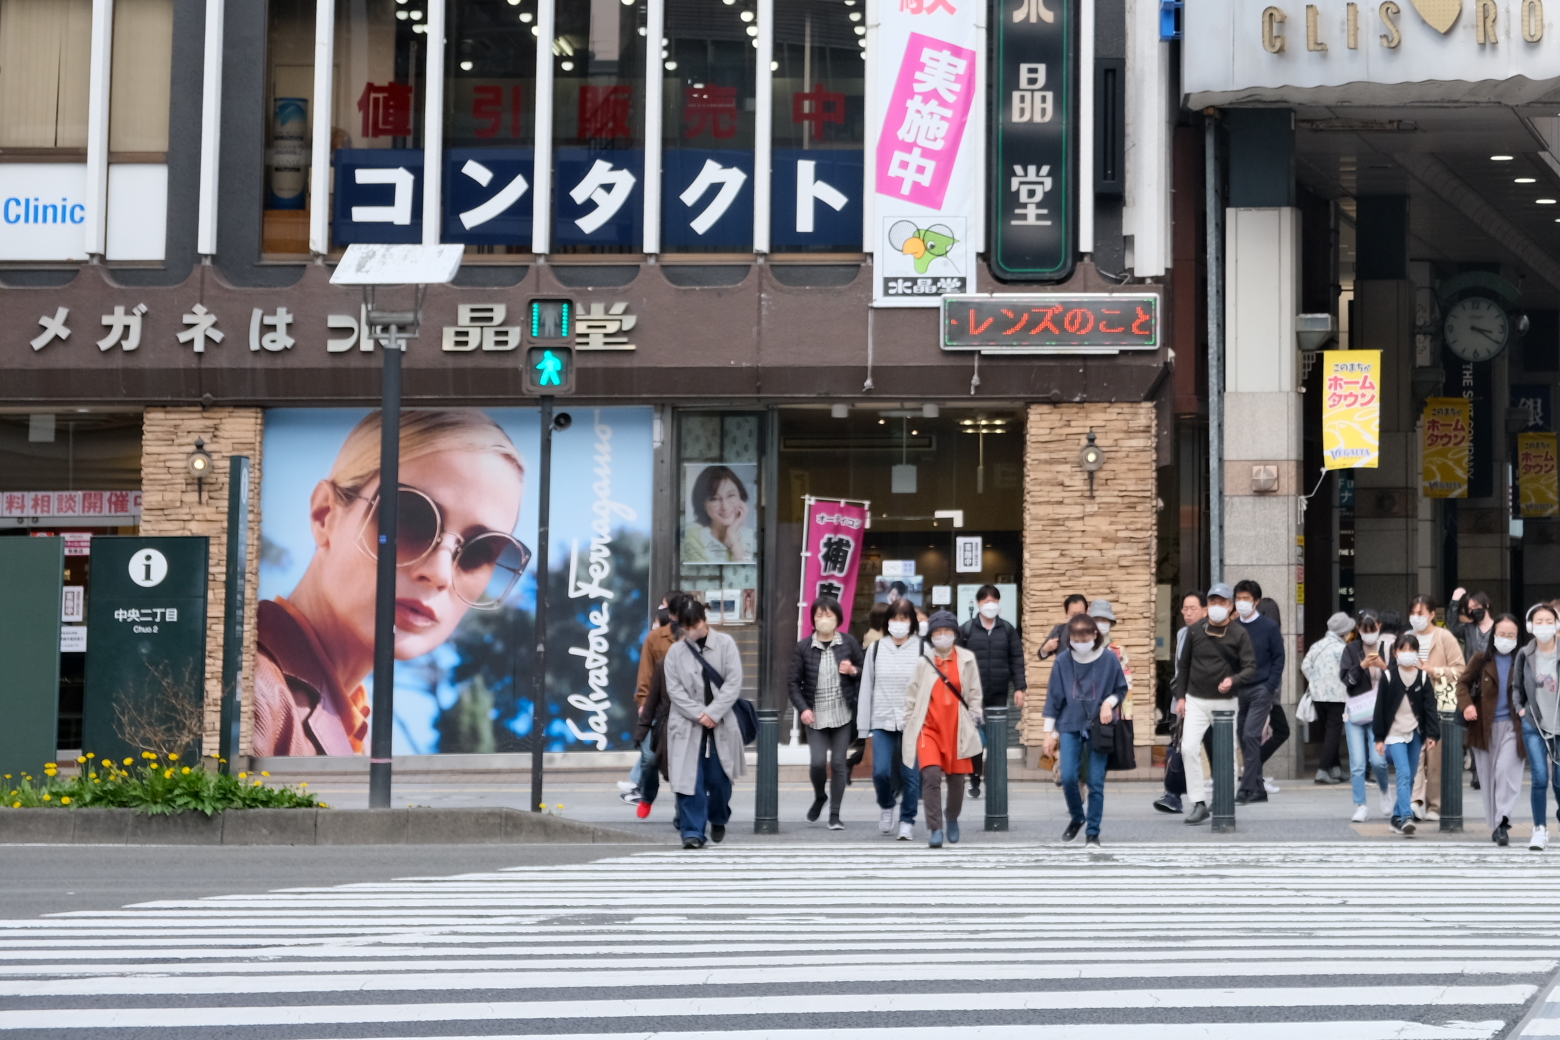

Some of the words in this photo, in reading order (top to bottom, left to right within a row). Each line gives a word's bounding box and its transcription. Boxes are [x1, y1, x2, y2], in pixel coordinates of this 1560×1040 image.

[1261, 0, 1402, 55] CLIS
[356, 81, 846, 139] 値引販売中
[887, 46, 966, 197] 実施中
[351, 158, 849, 235] コンタクト
[3, 197, 86, 225] Clinic
[888, 277, 962, 295] 水晶堂
[950, 304, 1151, 335] レンズのこと
[1333, 363, 1372, 373] このまちが
[1462, 363, 1473, 387] THE
[1327, 374, 1377, 391] ホーム
[1327, 391, 1377, 409] タウン
[1426, 418, 1466, 433] ホーム
[1426, 433, 1466, 447] タウン
[1330, 447, 1371, 461] VEGALTA
[1521, 450, 1555, 462] ホーム
[1521, 463, 1555, 475] タウン
[567, 408, 637, 600] Ferragamo
[816, 512, 863, 529] オーティコン
[114, 608, 178, 622] 中央二丁目
[566, 602, 612, 751] Salvatore
